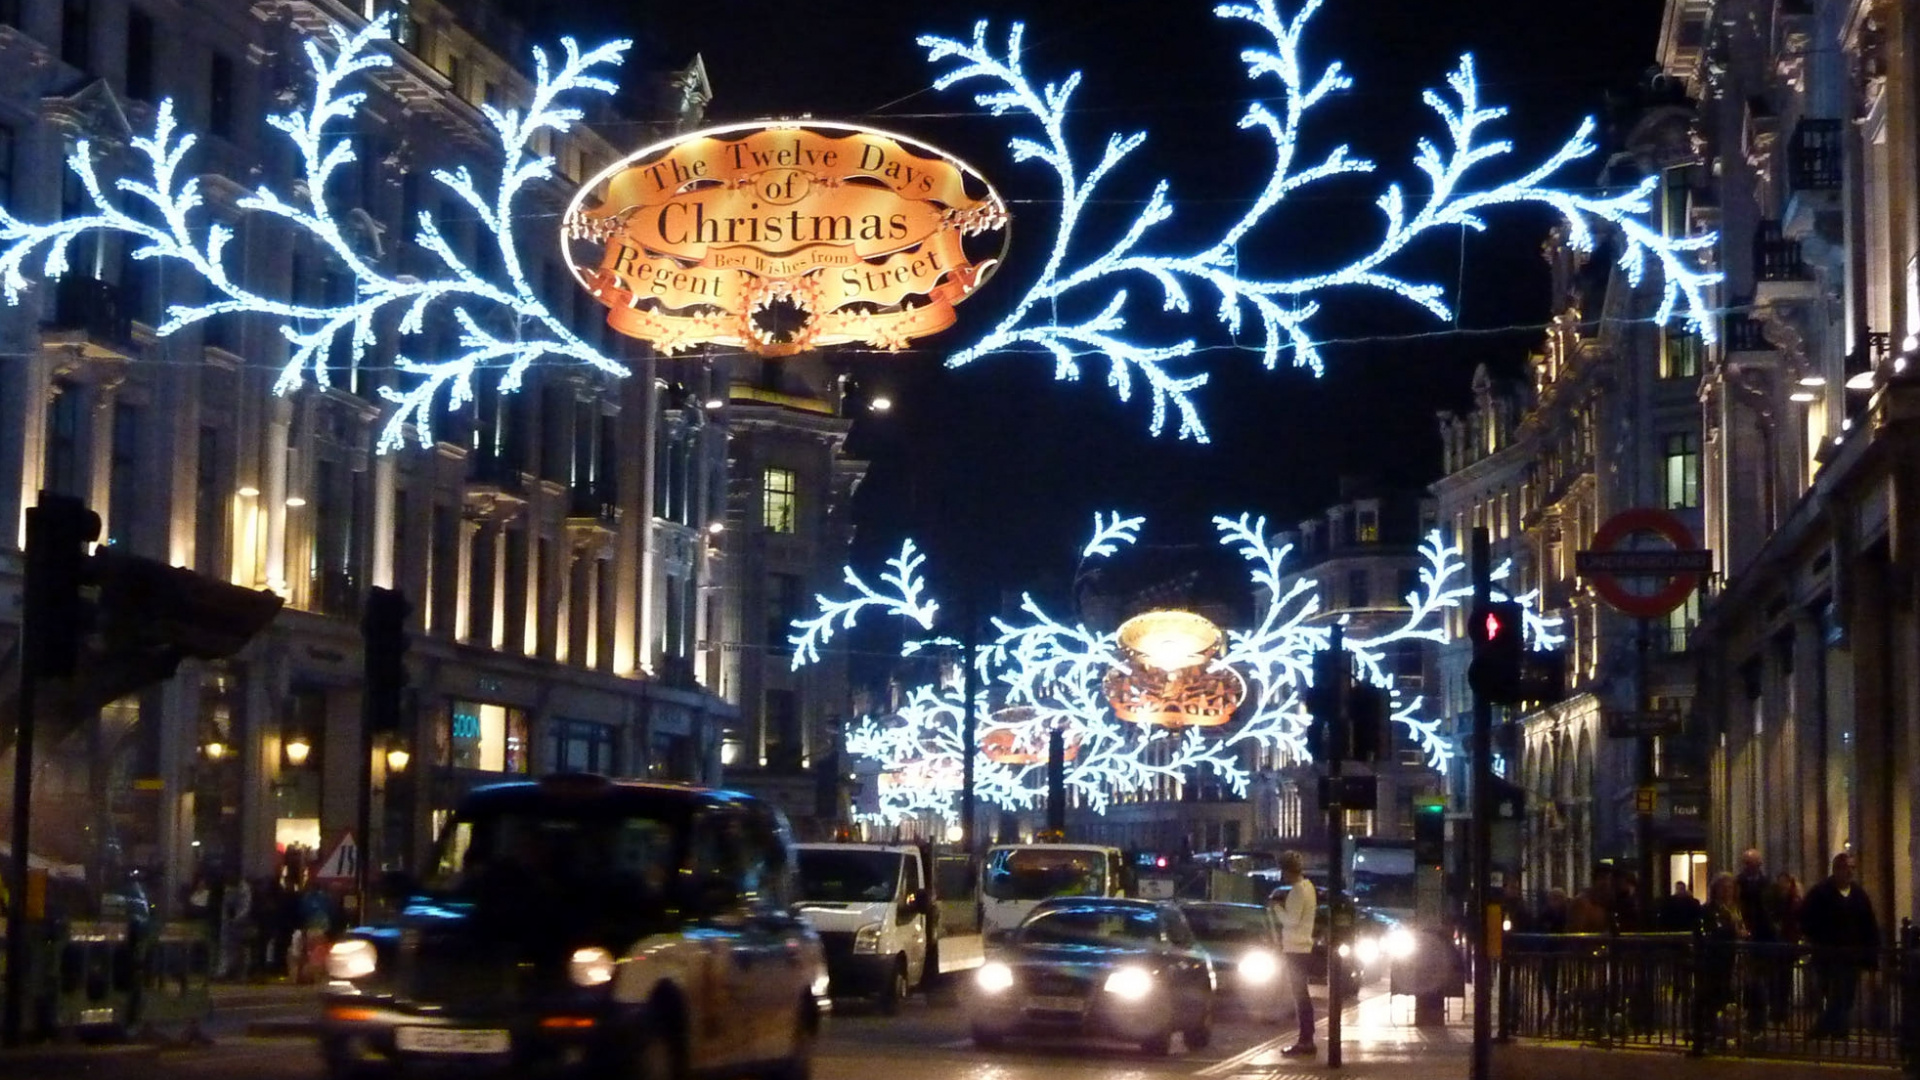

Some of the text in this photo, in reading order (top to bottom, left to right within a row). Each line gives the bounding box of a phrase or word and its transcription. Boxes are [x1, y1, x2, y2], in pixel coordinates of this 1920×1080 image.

[644, 139, 935, 192] The Twelve Days
[765, 172, 798, 199] of
[657, 202, 908, 245] Christmas
[612, 245, 944, 297] Regent Street
[715, 250, 848, 275] Best Wishes from
[1581, 554, 1707, 568] UNDERGROUND
